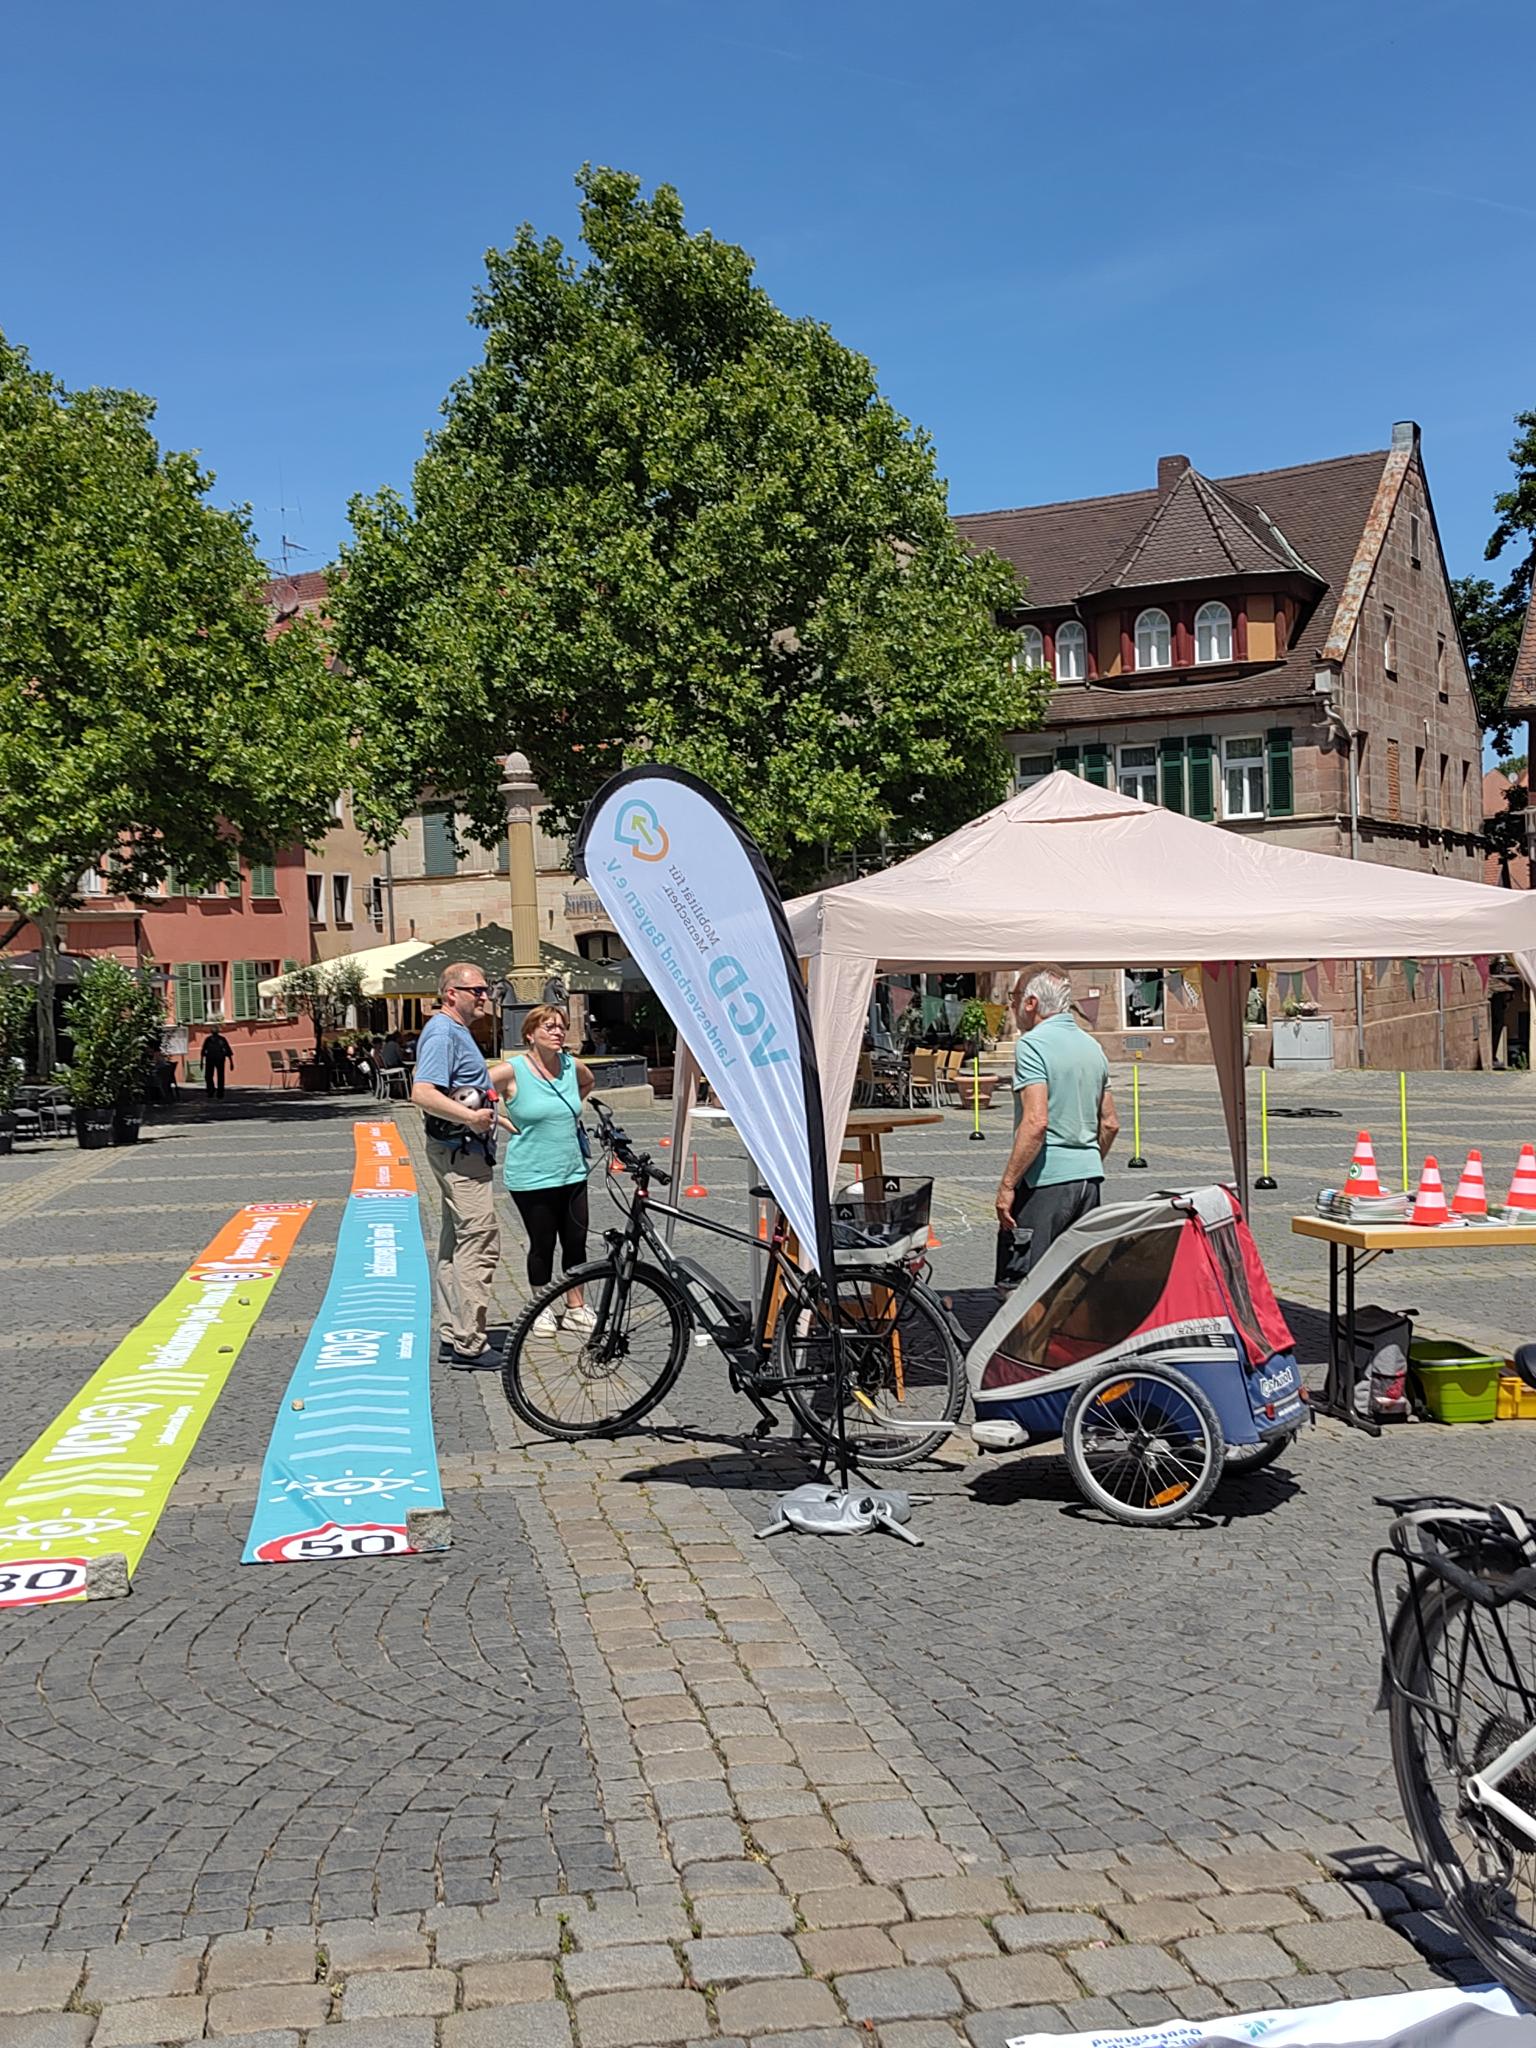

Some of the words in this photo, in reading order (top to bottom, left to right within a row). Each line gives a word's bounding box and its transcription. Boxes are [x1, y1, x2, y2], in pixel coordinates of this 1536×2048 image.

[314, 1342, 380, 1370] VCD
[42, 1419, 143, 1463] VCD
[299, 1534, 395, 1557] 50
[1092, 2028, 1203, 2047] Deutschland
